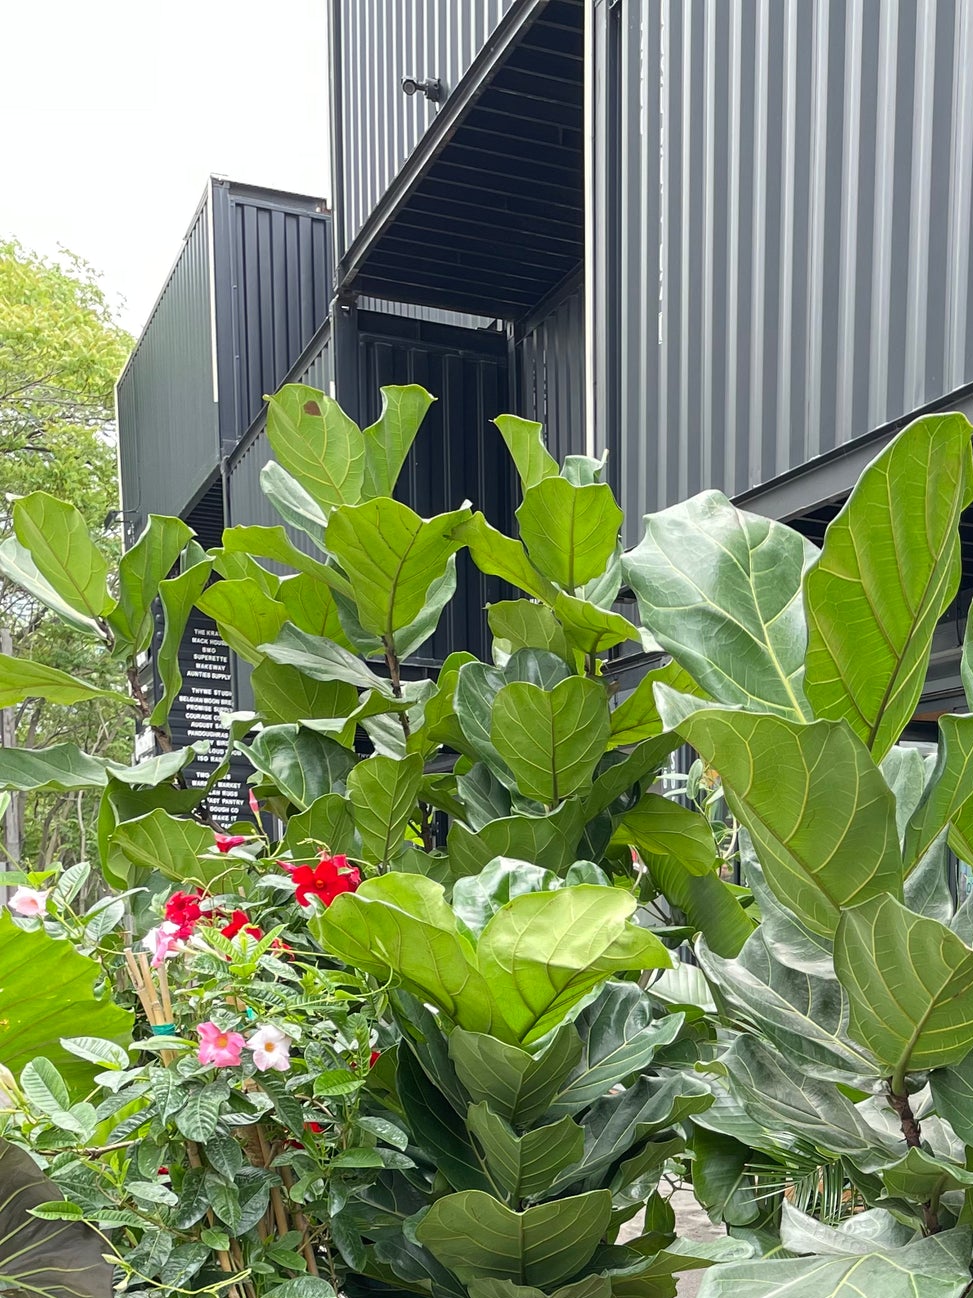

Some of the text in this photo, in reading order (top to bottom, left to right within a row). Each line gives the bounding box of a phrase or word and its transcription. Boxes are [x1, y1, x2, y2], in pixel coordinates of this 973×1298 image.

[194, 628, 205, 636] THE
[193, 653, 228, 663] SUPERETTE
[211, 672, 232, 681] SUPPLY
[185, 712, 212, 720] COURAGE
[221, 798, 244, 806] PANTRY
